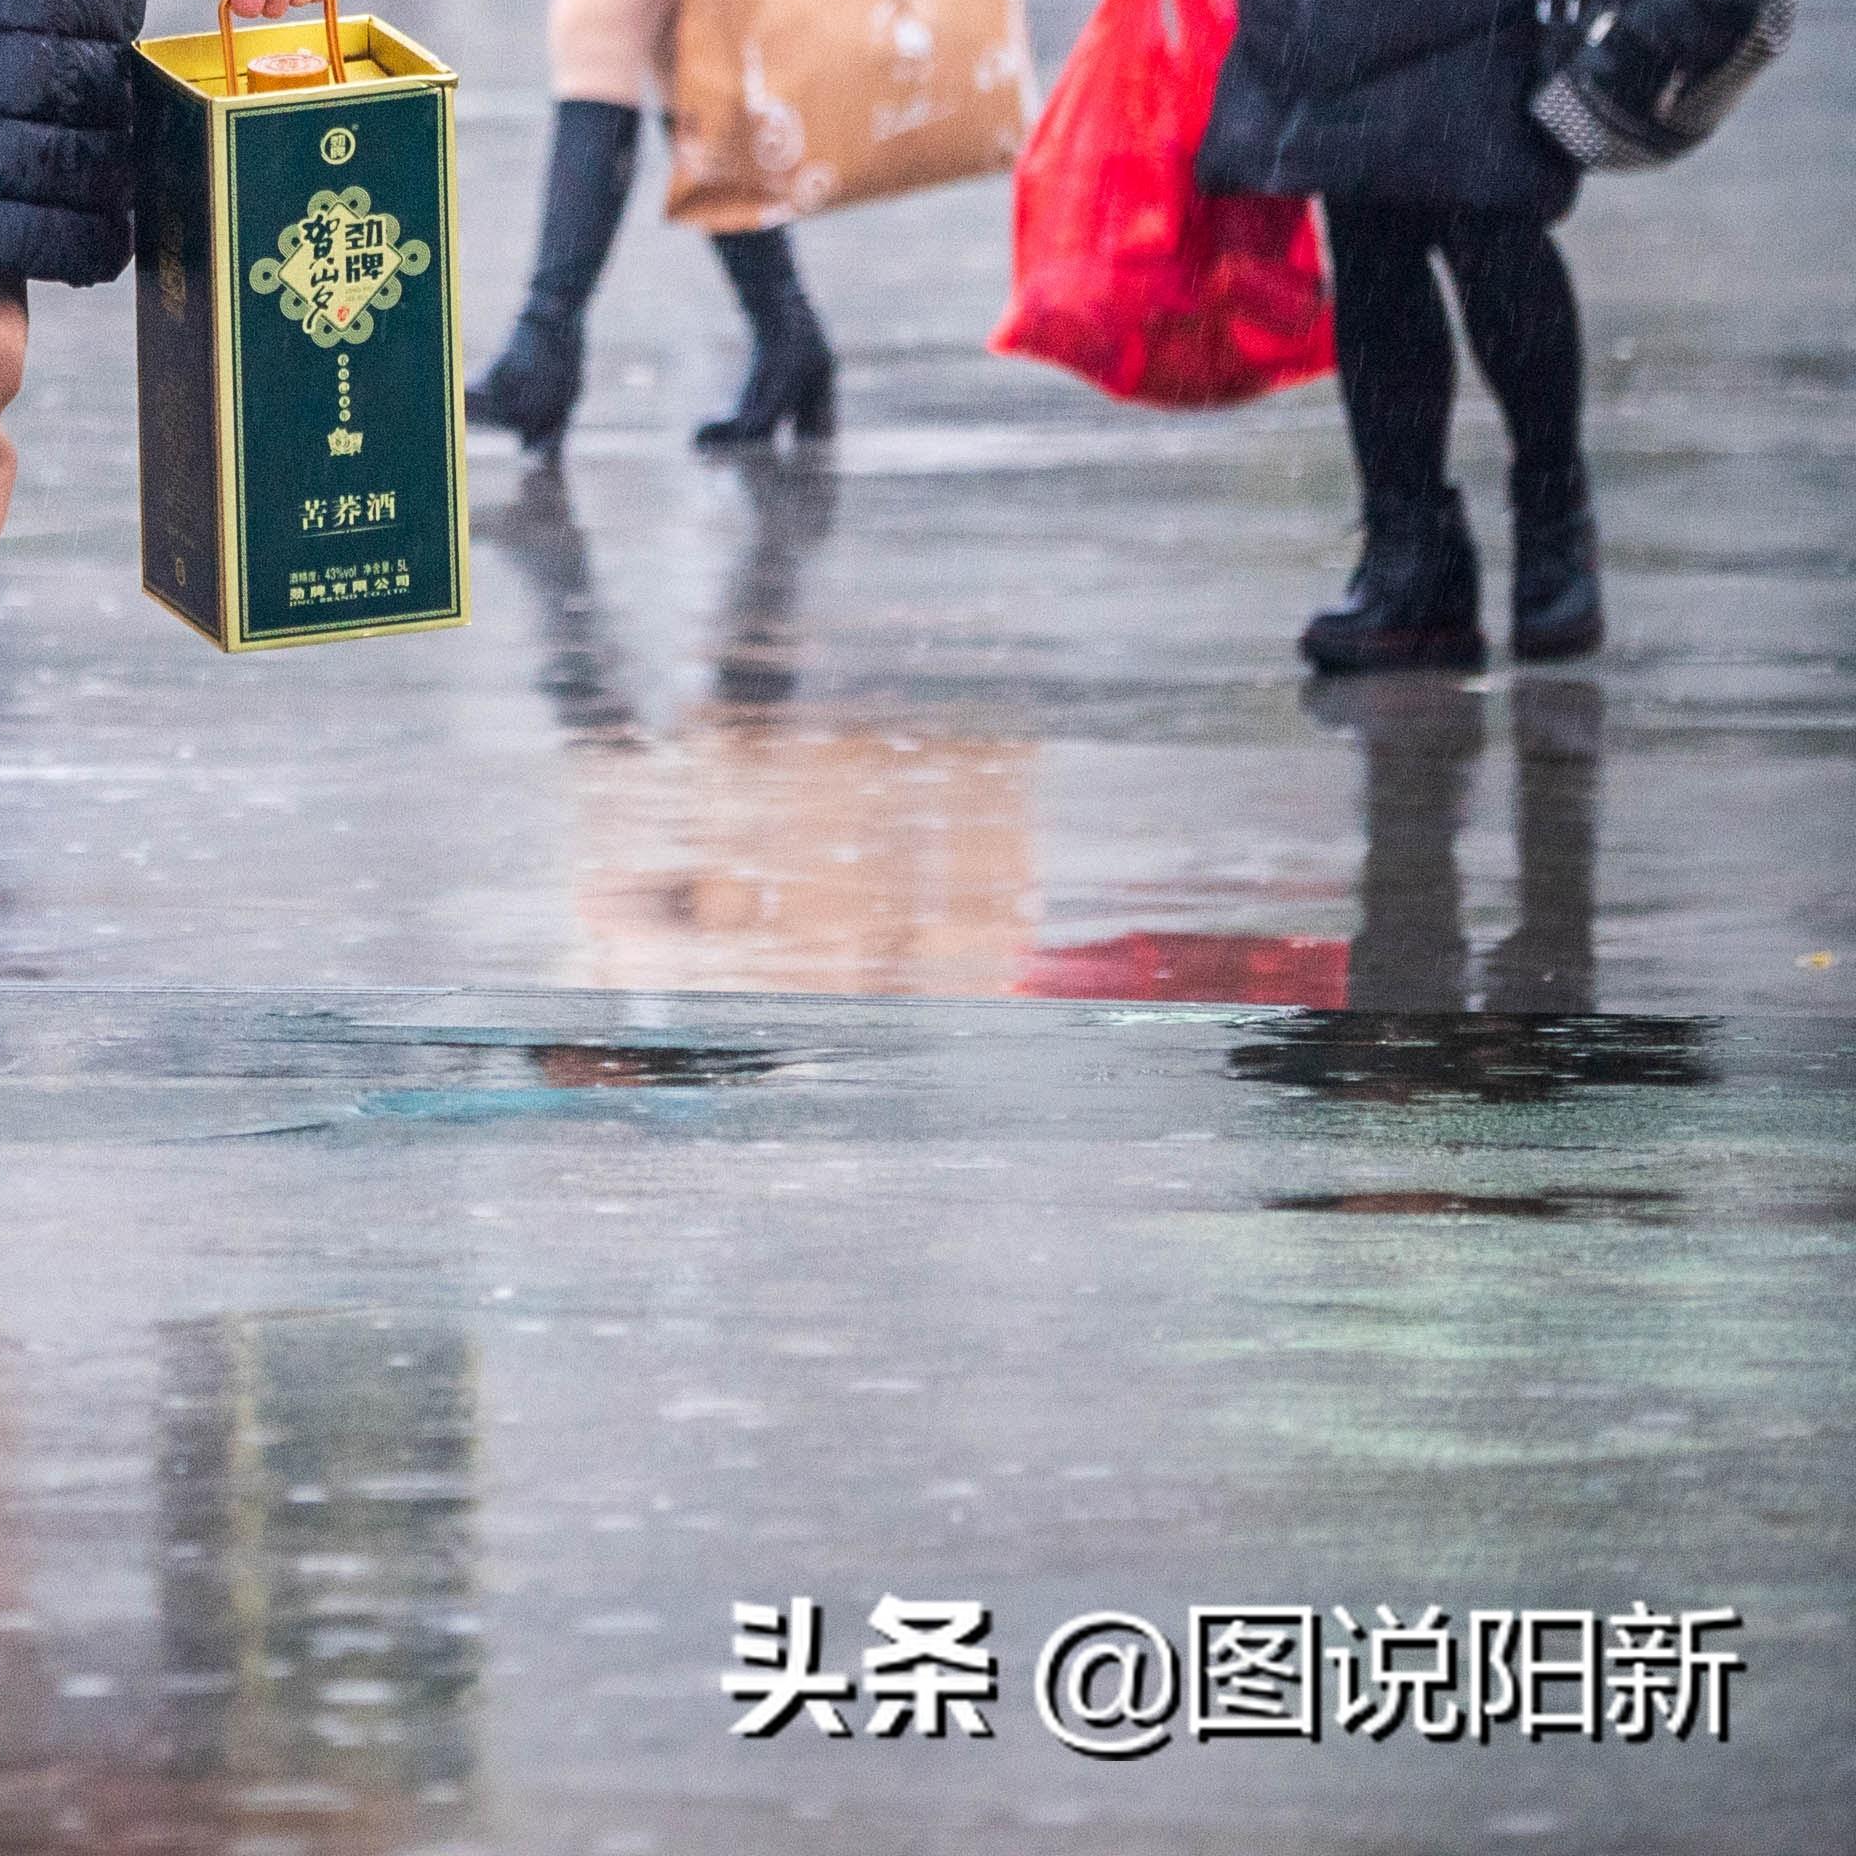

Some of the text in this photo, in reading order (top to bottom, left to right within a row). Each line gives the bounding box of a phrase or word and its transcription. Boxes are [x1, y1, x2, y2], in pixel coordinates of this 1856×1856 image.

[344, 218, 384, 284] 劲牌
[299, 491, 396, 531] 苦荞酒
